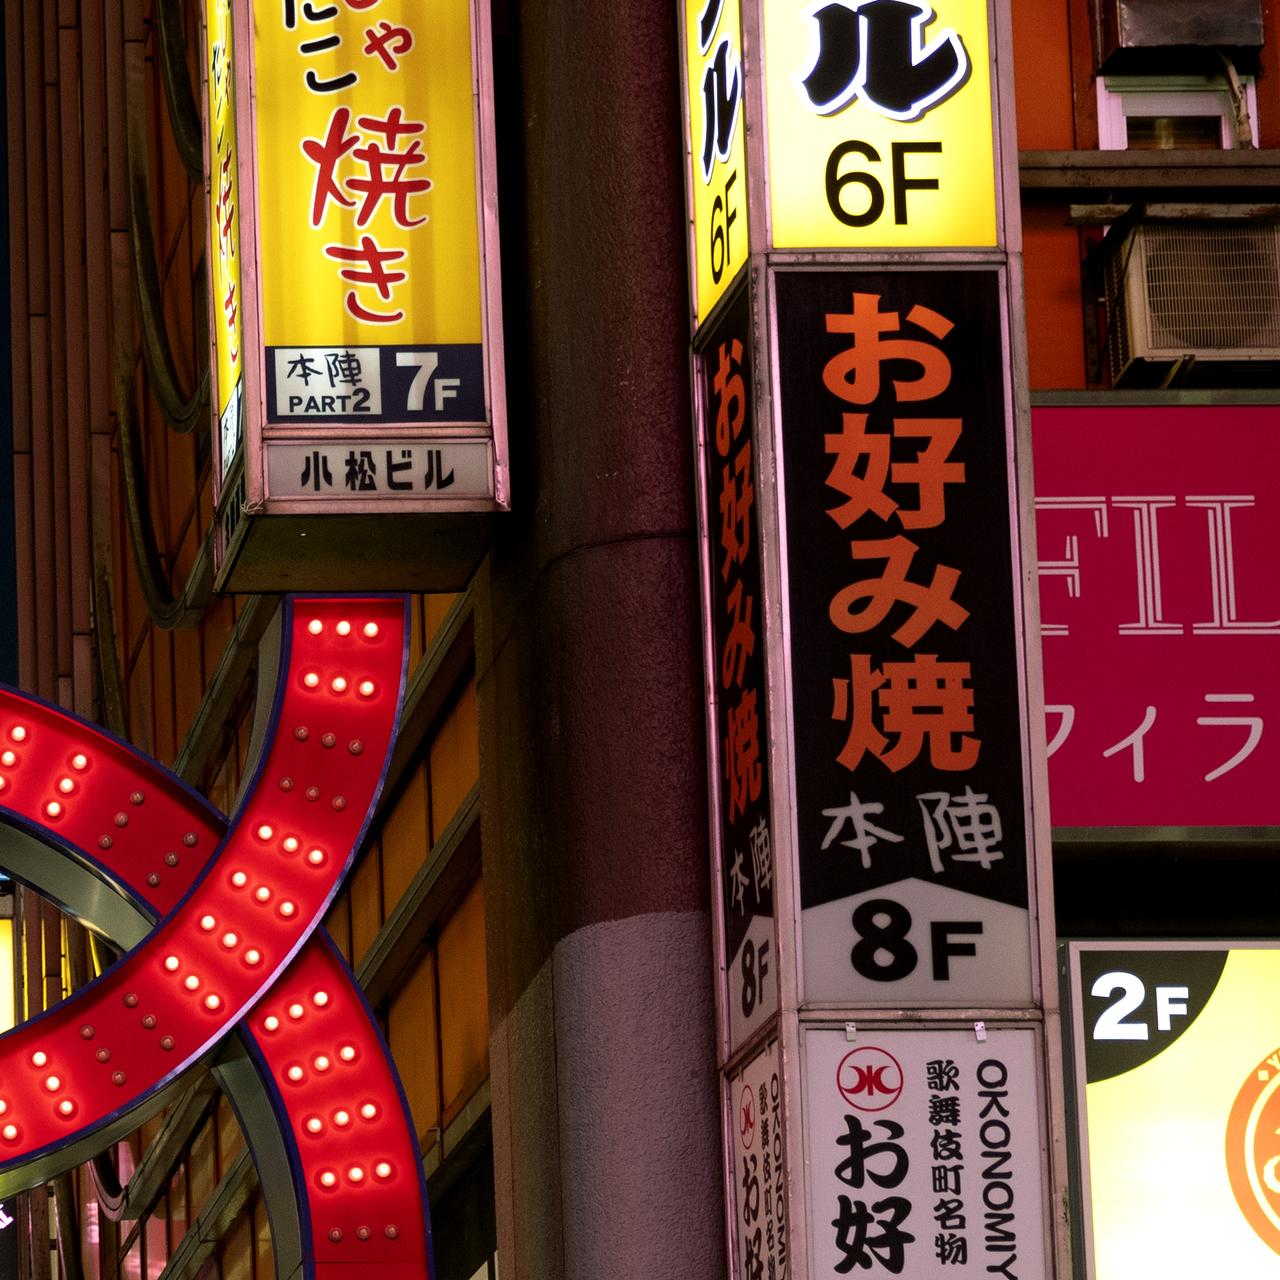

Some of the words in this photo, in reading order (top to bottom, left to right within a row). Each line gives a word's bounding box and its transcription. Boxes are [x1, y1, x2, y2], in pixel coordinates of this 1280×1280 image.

[302, 107, 431, 324] 焼き
[825, 141, 943, 228] 6F
[287, 353, 363, 388] 本陣
[395, 352, 461, 412] 7F
[301, 451, 456, 492] 小松ビル
[821, 292, 982, 773] お好み焼
[820, 785, 1004, 873] 本陣
[850, 898, 984, 983] 8F
[1090, 970, 1189, 1041] 2F
[924, 1059, 969, 1266] 歌舞伎町名物
